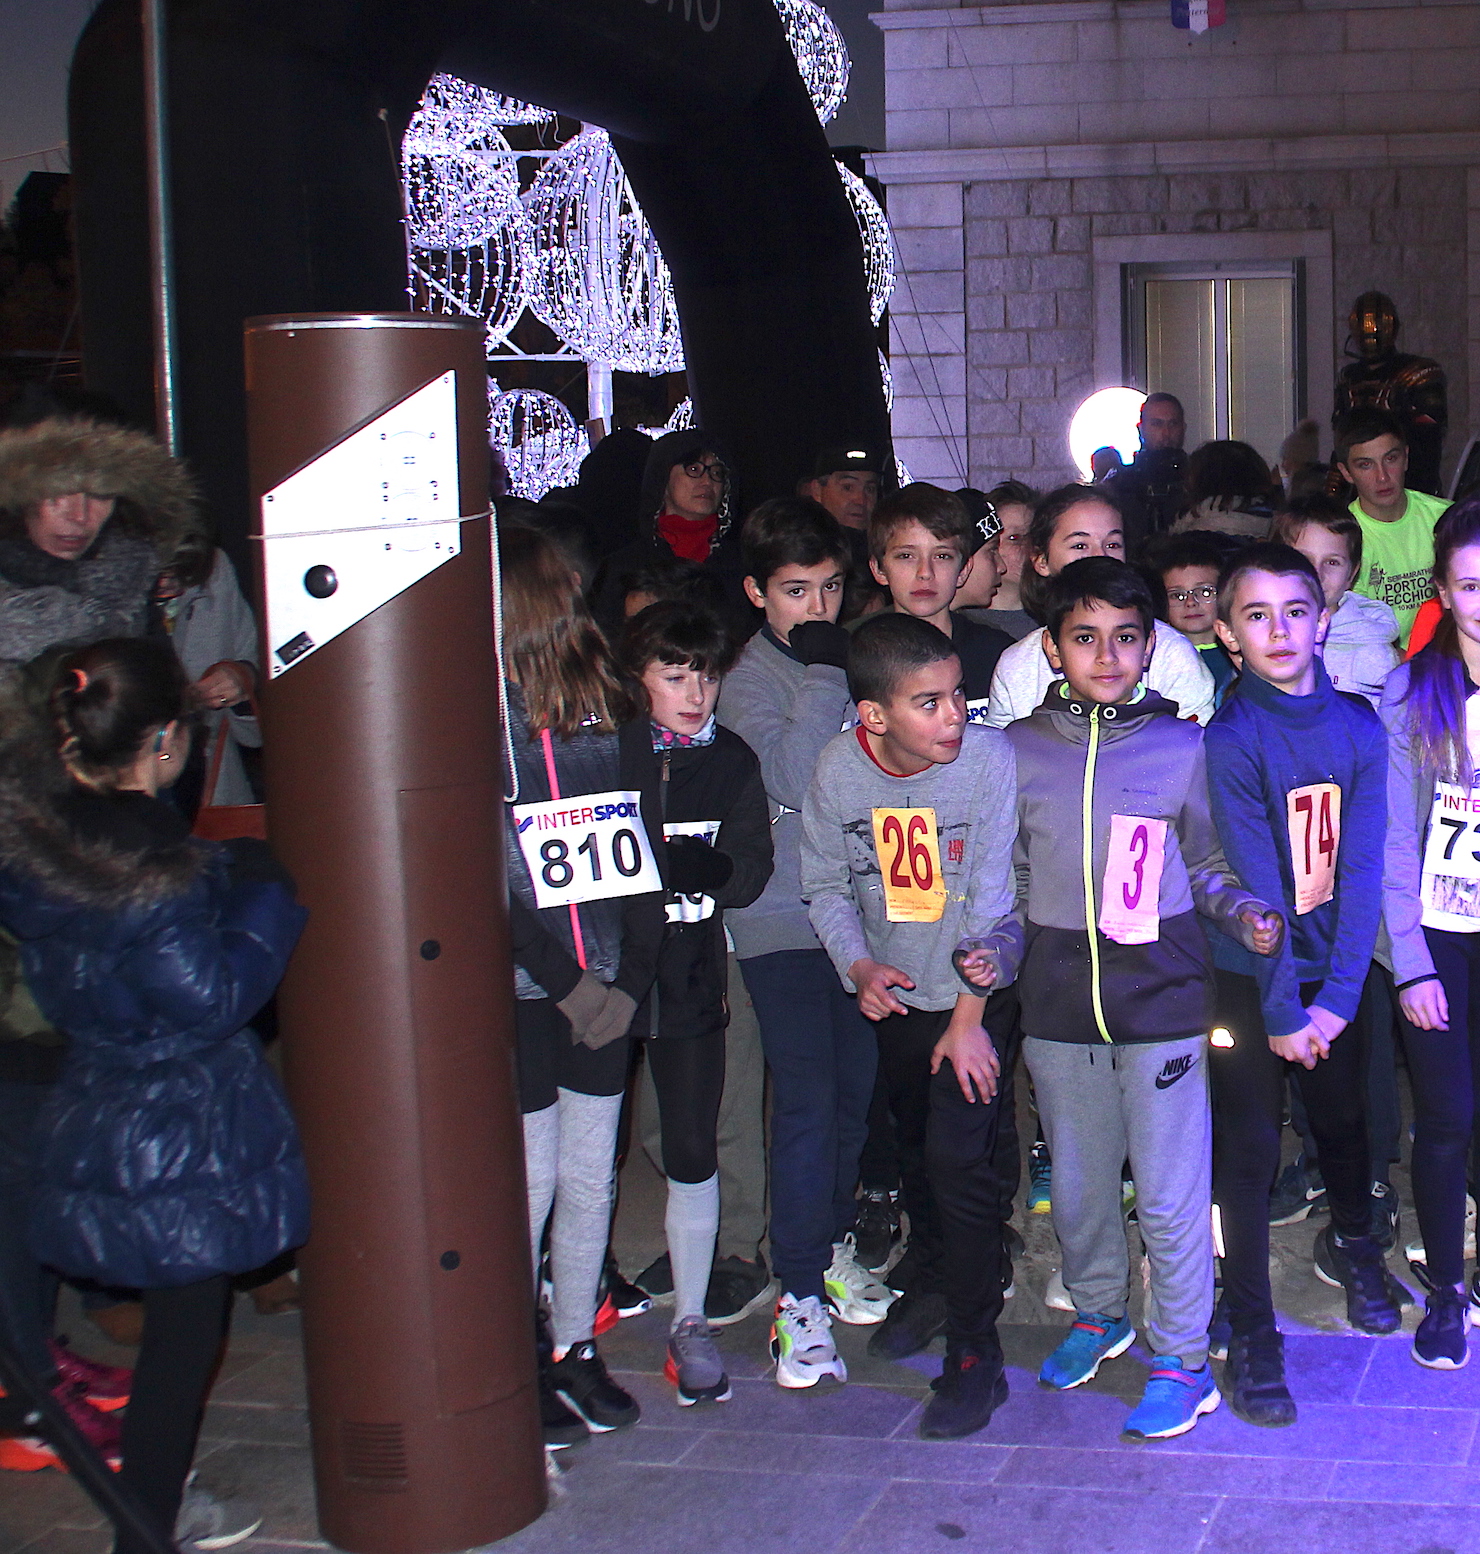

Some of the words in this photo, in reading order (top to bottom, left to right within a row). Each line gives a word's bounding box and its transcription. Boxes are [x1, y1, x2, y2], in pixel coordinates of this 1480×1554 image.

[537, 802, 639, 831] INTERSPORT
[1295, 791, 1335, 875] 74
[540, 828, 642, 889] 810
[882, 815, 933, 891] 26
[1122, 824, 1149, 910] 3
[1162, 1054, 1192, 1076] NIKE
